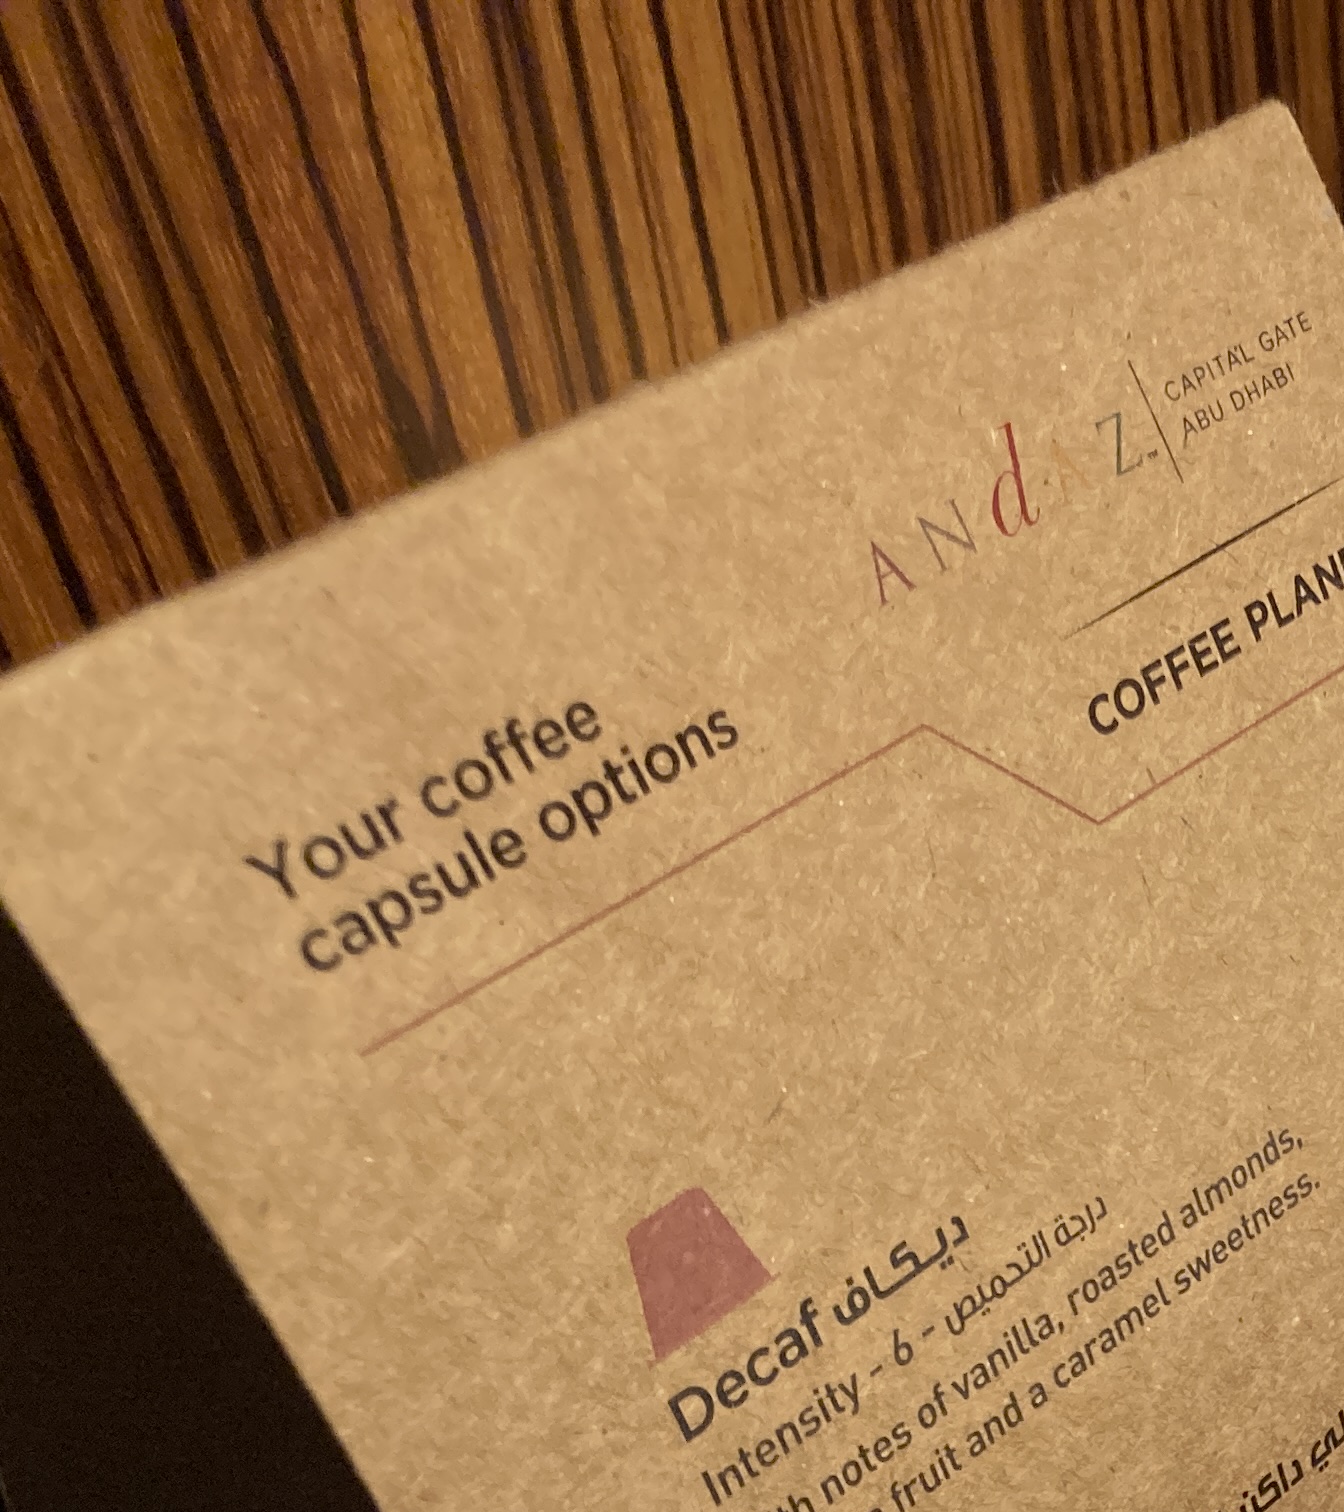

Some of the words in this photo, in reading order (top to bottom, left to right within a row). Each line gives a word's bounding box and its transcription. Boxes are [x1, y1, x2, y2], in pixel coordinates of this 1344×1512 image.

[1163, 345, 1255, 402] CAPITAL
[1258, 310, 1312, 353] GATE
[1181, 403, 1226, 446] ABU
[1229, 362, 1295, 414] DHABI
[1087, 617, 1242, 736] COFFEE
[245, 798, 404, 900] Your
[420, 701, 603, 818] coffee
[300, 826, 528, 972] capsule
[538, 709, 740, 842] options
[820, 1420, 913, 1505] notes
[917, 1386, 947, 1432] of
[951, 1315, 1066, 1400] vanilla,
[1066, 1219, 1177, 1316] roasted
[1180, 1124, 1305, 1225] almonds,
[833, 1214, 970, 1325] ديكاف
[967, 1401, 1027, 1460] and
[1030, 1387, 1050, 1412] a
[1053, 1280, 1172, 1387] caramel
[1174, 1176, 1322, 1295] sweetness.
[667, 1301, 836, 1443] Decaf
[702, 1378, 861, 1505] Intensity
